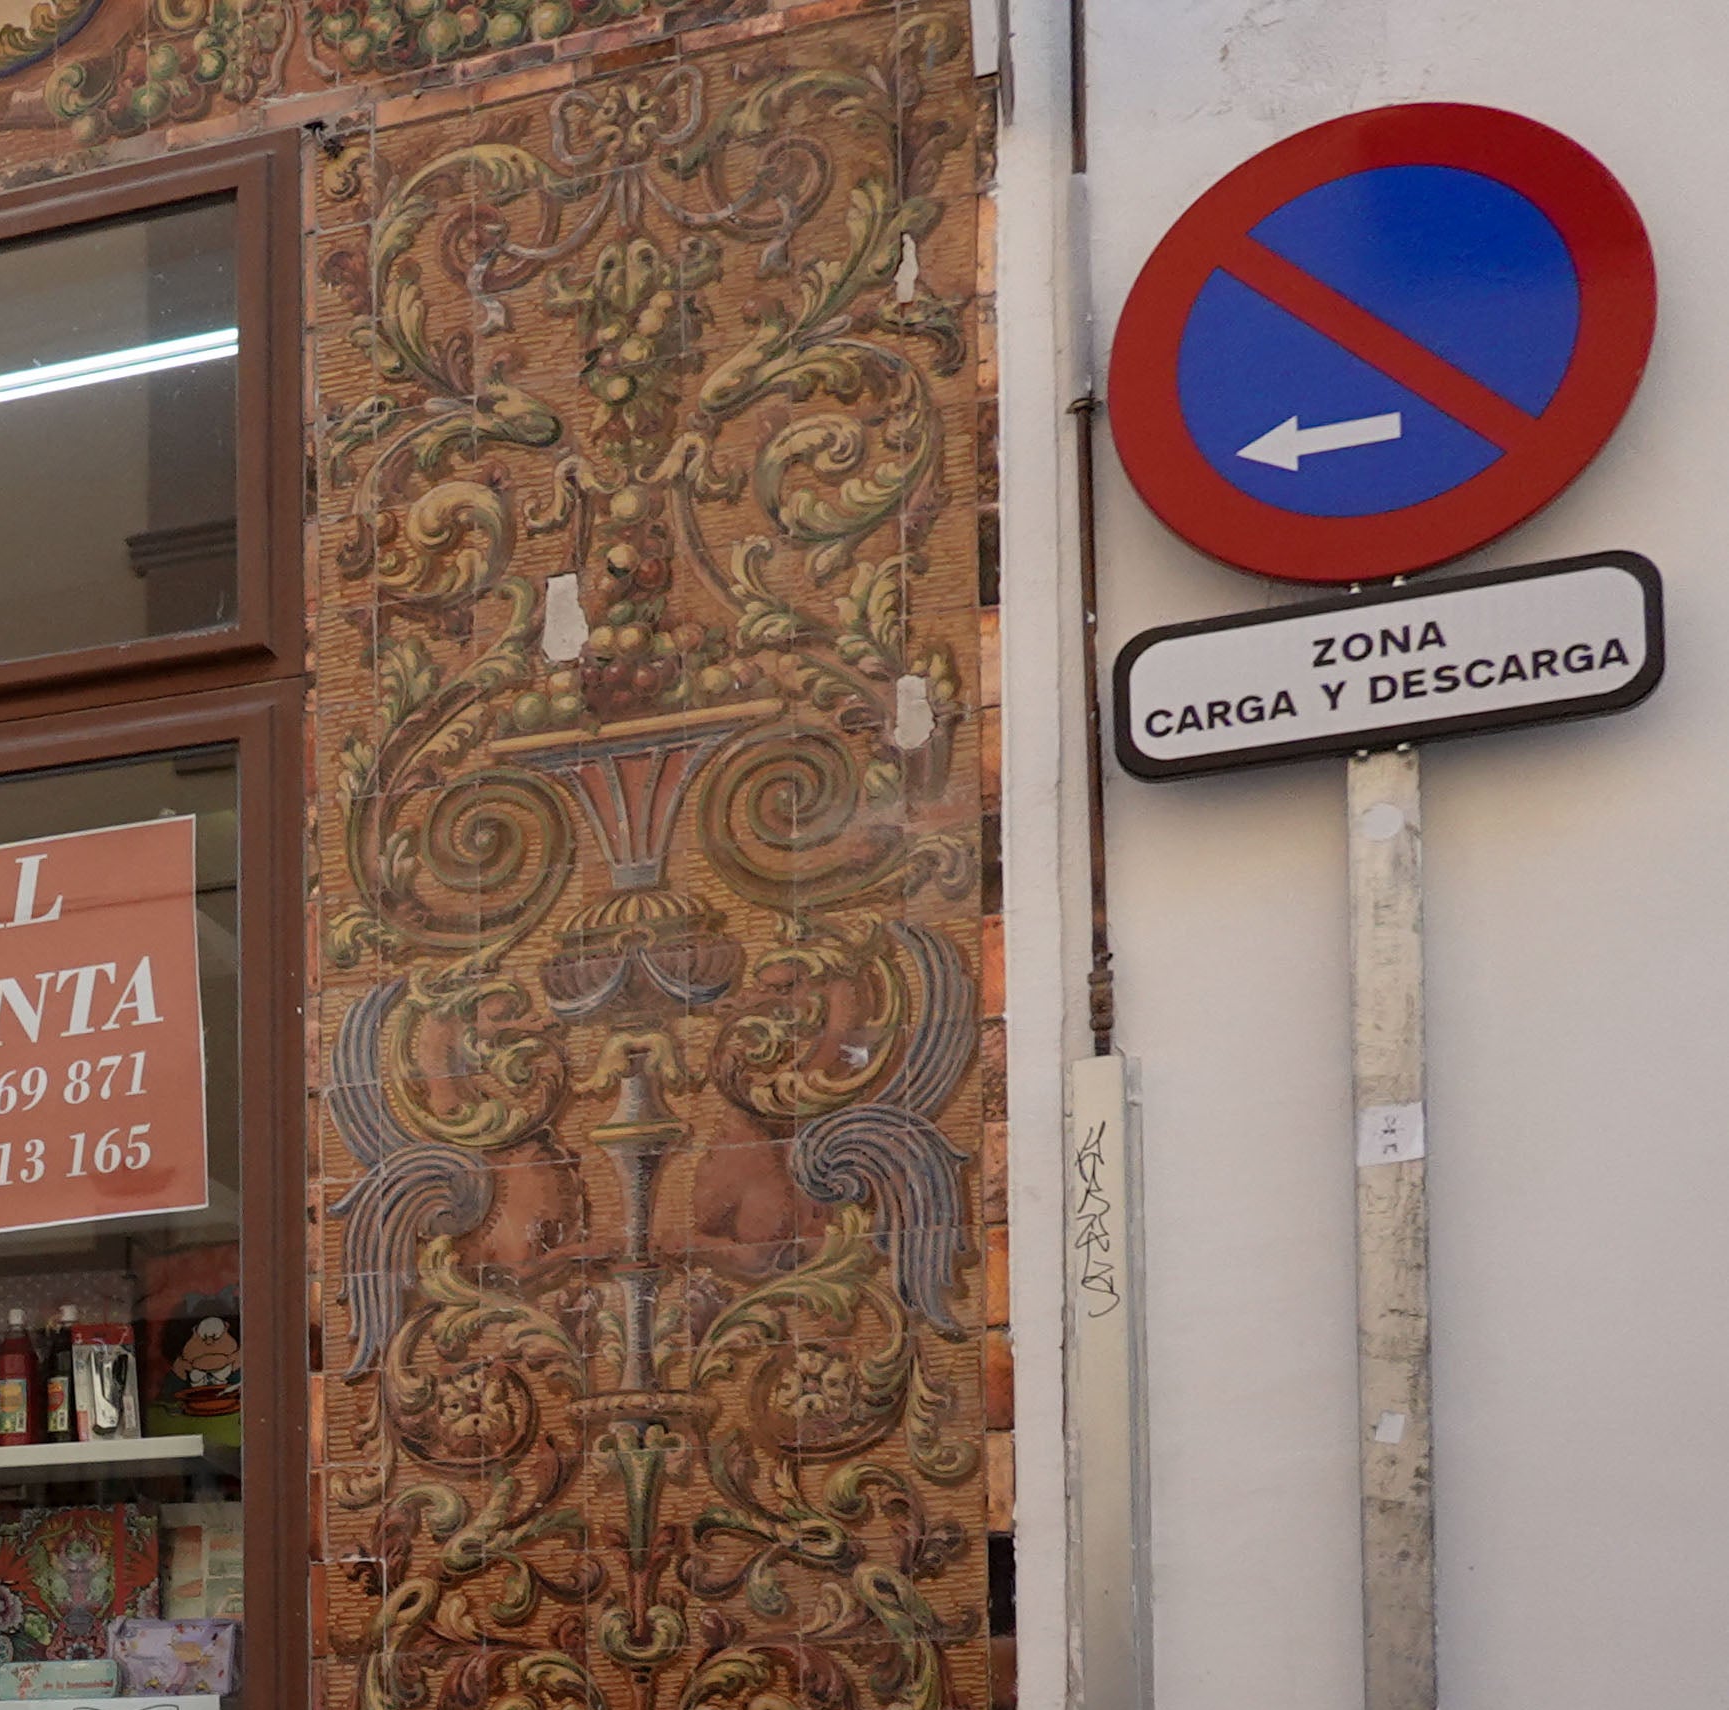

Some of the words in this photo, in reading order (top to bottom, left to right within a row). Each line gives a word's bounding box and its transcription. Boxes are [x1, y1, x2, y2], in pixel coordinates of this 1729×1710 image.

[1312, 621, 1447, 668] ZONA
[1144, 688, 1298, 739] CARGA
[1321, 680, 1350, 713] Y
[1369, 637, 1631, 704] DESCARGA
[62, 1050, 149, 1107] 871
[64, 1122, 153, 1179] 165
